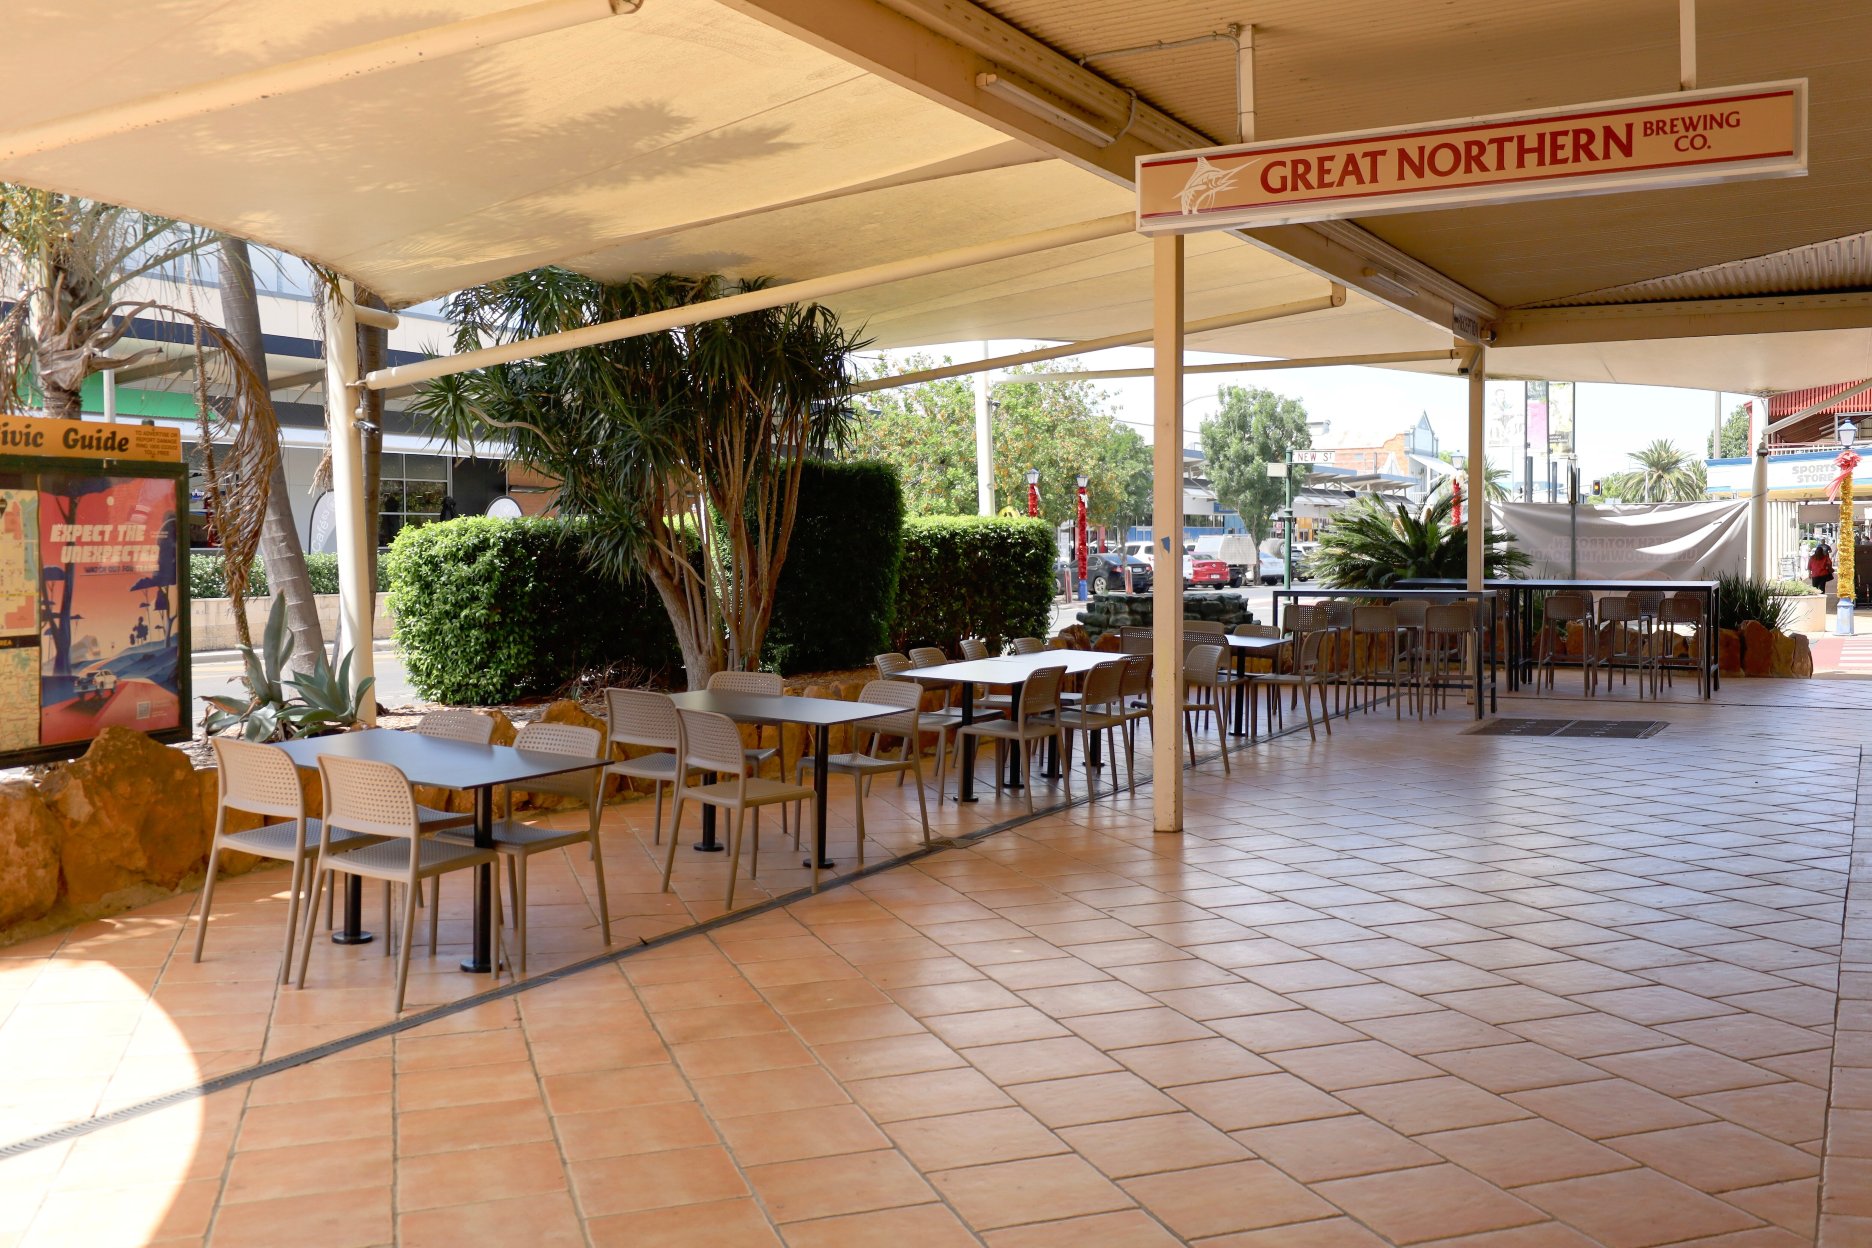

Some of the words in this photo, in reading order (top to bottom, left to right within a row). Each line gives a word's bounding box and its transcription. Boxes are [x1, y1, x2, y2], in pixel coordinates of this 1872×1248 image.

[1674, 133, 1712, 153] CO.
[1259, 150, 1387, 195] GREAT
[1396, 122, 1635, 182] NORTHERN
[1643, 110, 1741, 138] BREWING
[0, 421, 44, 448] ivic
[62, 427, 129, 452] Guide
[1297, 452, 1317, 462] NEW
[1323, 452, 1333, 462] ST
[1792, 463, 1838, 475] SPORTS
[1797, 473, 1834, 483] STORE
[50, 523, 114, 542] EXPECT
[117, 523, 147, 542] THE
[61, 545, 160, 563] UNEXPECTED
